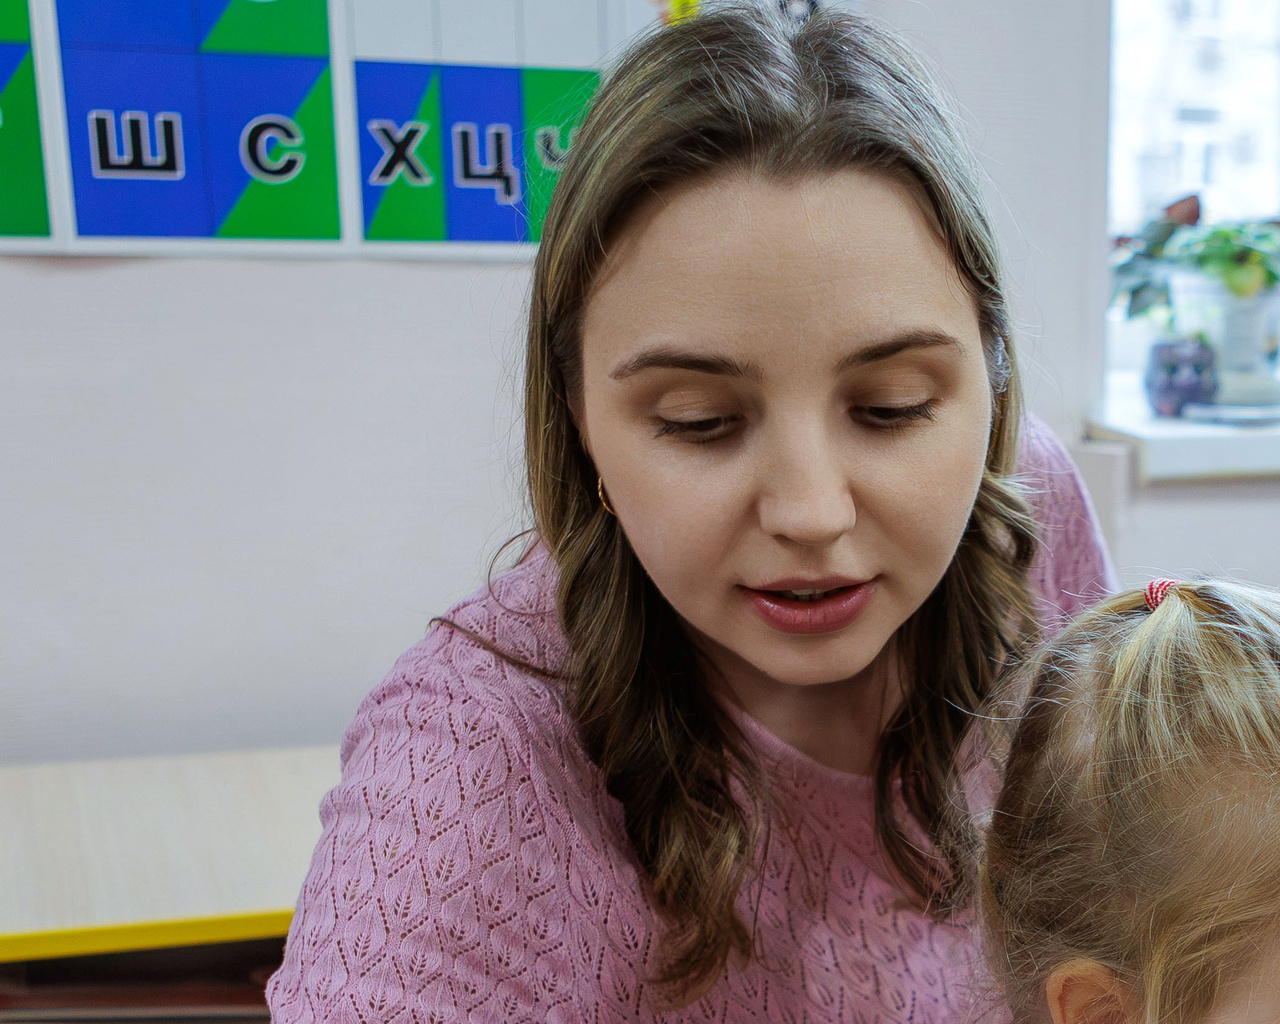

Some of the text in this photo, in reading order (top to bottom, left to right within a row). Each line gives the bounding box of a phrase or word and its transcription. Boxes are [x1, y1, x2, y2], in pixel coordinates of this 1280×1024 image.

[89, 110, 304, 184] Ш С
[369, 120, 432, 186] Х
[453, 123, 519, 203] Ц
